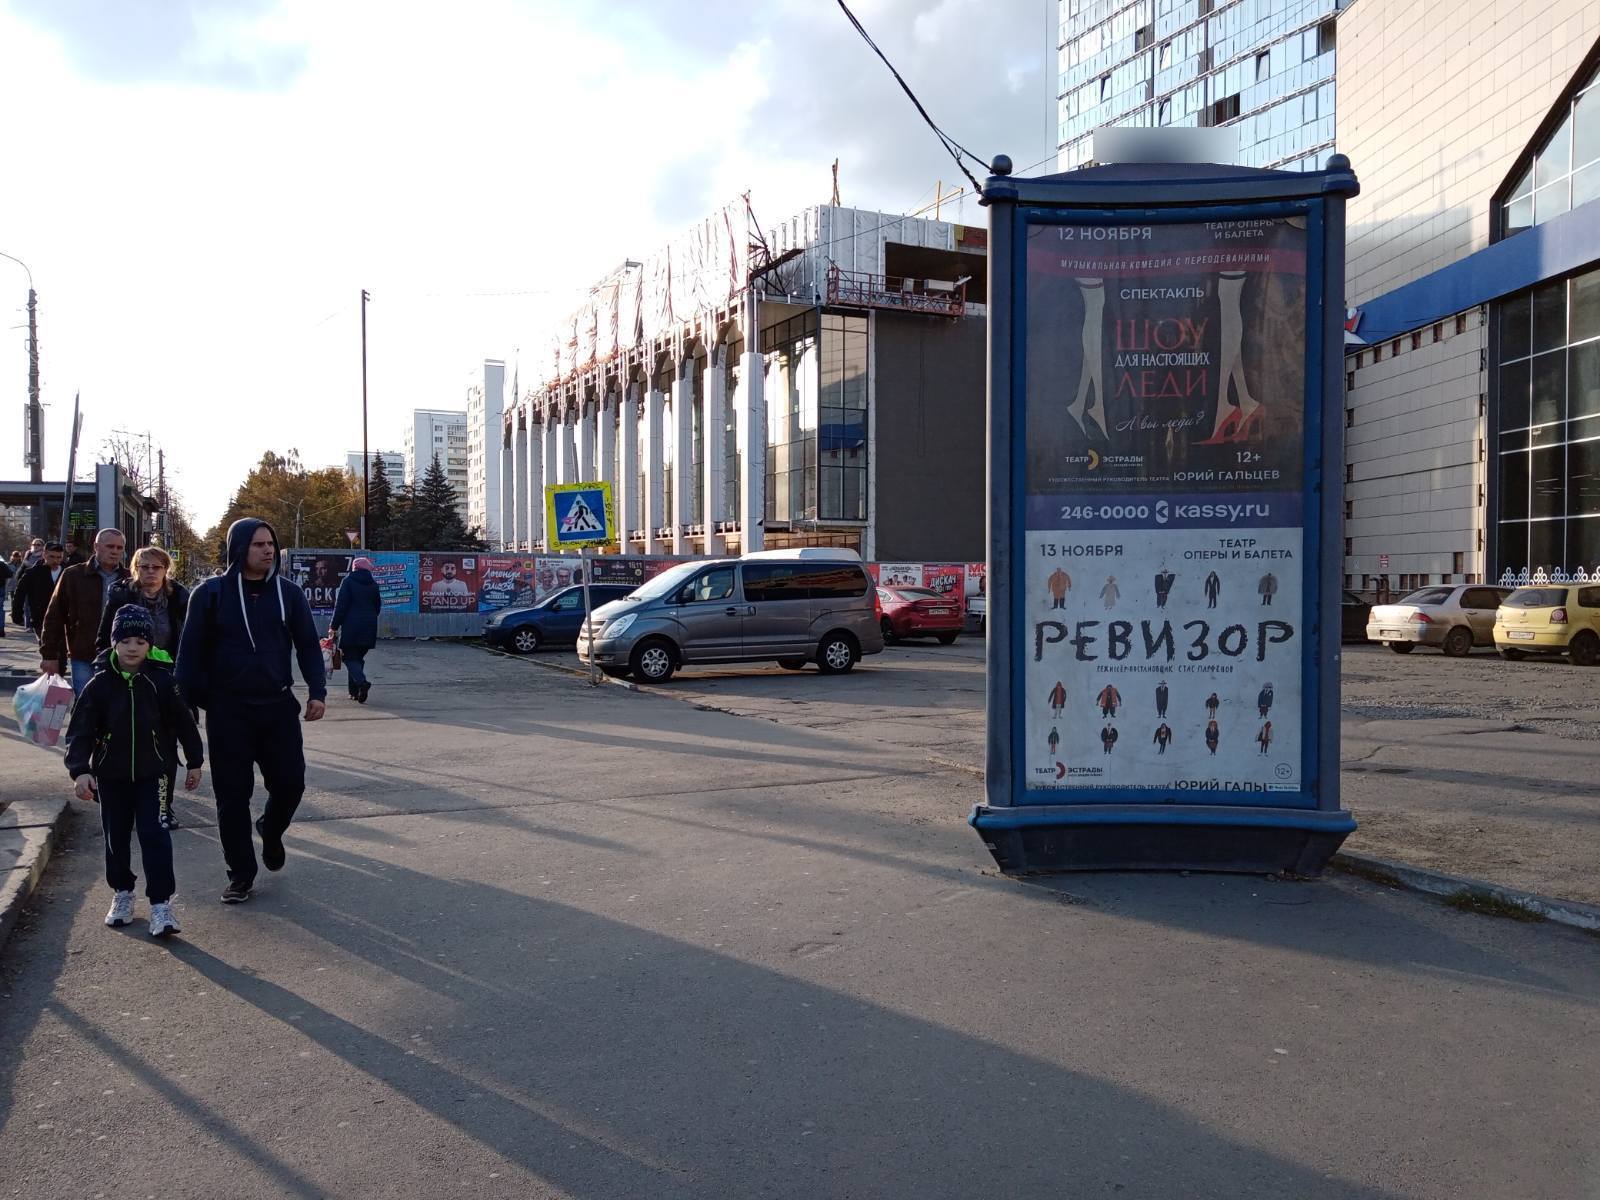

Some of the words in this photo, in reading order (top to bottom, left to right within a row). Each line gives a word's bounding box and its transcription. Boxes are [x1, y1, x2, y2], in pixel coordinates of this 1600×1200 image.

[1204, 221, 1235, 230] ТЕАТР
[1057, 227, 1074, 241] 12
[1080, 226, 1152, 241] НОЯБРЯ
[1214, 231, 1222, 240] И
[1224, 229, 1264, 240] БАЛЕТА
[1060, 258, 1126, 271] МУЗЫКАЛЬНАЯ
[1129, 257, 1172, 270] КОМЕДИЯ
[1184, 253, 1271, 266] ПЕРЕОДЕВАНИЯМИ
[1120, 286, 1205, 301] СПЕКТАКЛЬ
[1116, 317, 1209, 352] ШОУ
[1114, 353, 1139, 368] ДЛЯ
[1141, 351, 1211, 367] НАСТОЯЩИХ
[1115, 368, 1208, 398] ЛЕДИ
[1065, 455, 1089, 464] ТЕАТР
[1102, 455, 1144, 464] ЭСТРАДЫ
[1235, 450, 1262, 464] 12+
[1173, 468, 1214, 481] ЮРИЙ
[1218, 469, 1281, 481] ГАЛЬЦЕВ
[1060, 505, 1150, 520] 246-0000
[1174, 503, 1270, 522] kassy.ru
[1039, 543, 1057, 557] 13
[1061, 543, 1124, 557] НОЯБРЯ
[1218, 538, 1257, 549] ТЕАТР
[1183, 549, 1229, 560] ОПЕРЫ
[1230, 550, 1241, 560] И
[1243, 548, 1294, 560] БАЛЕТА
[422, 596, 459, 606] STAND
[460, 596, 476, 606] UP
[1034, 620, 1295, 663] РЕВИЗОР
[1035, 767, 1056, 775] ТЕАТР
[1174, 778, 1220, 791] ЮРИЙ
